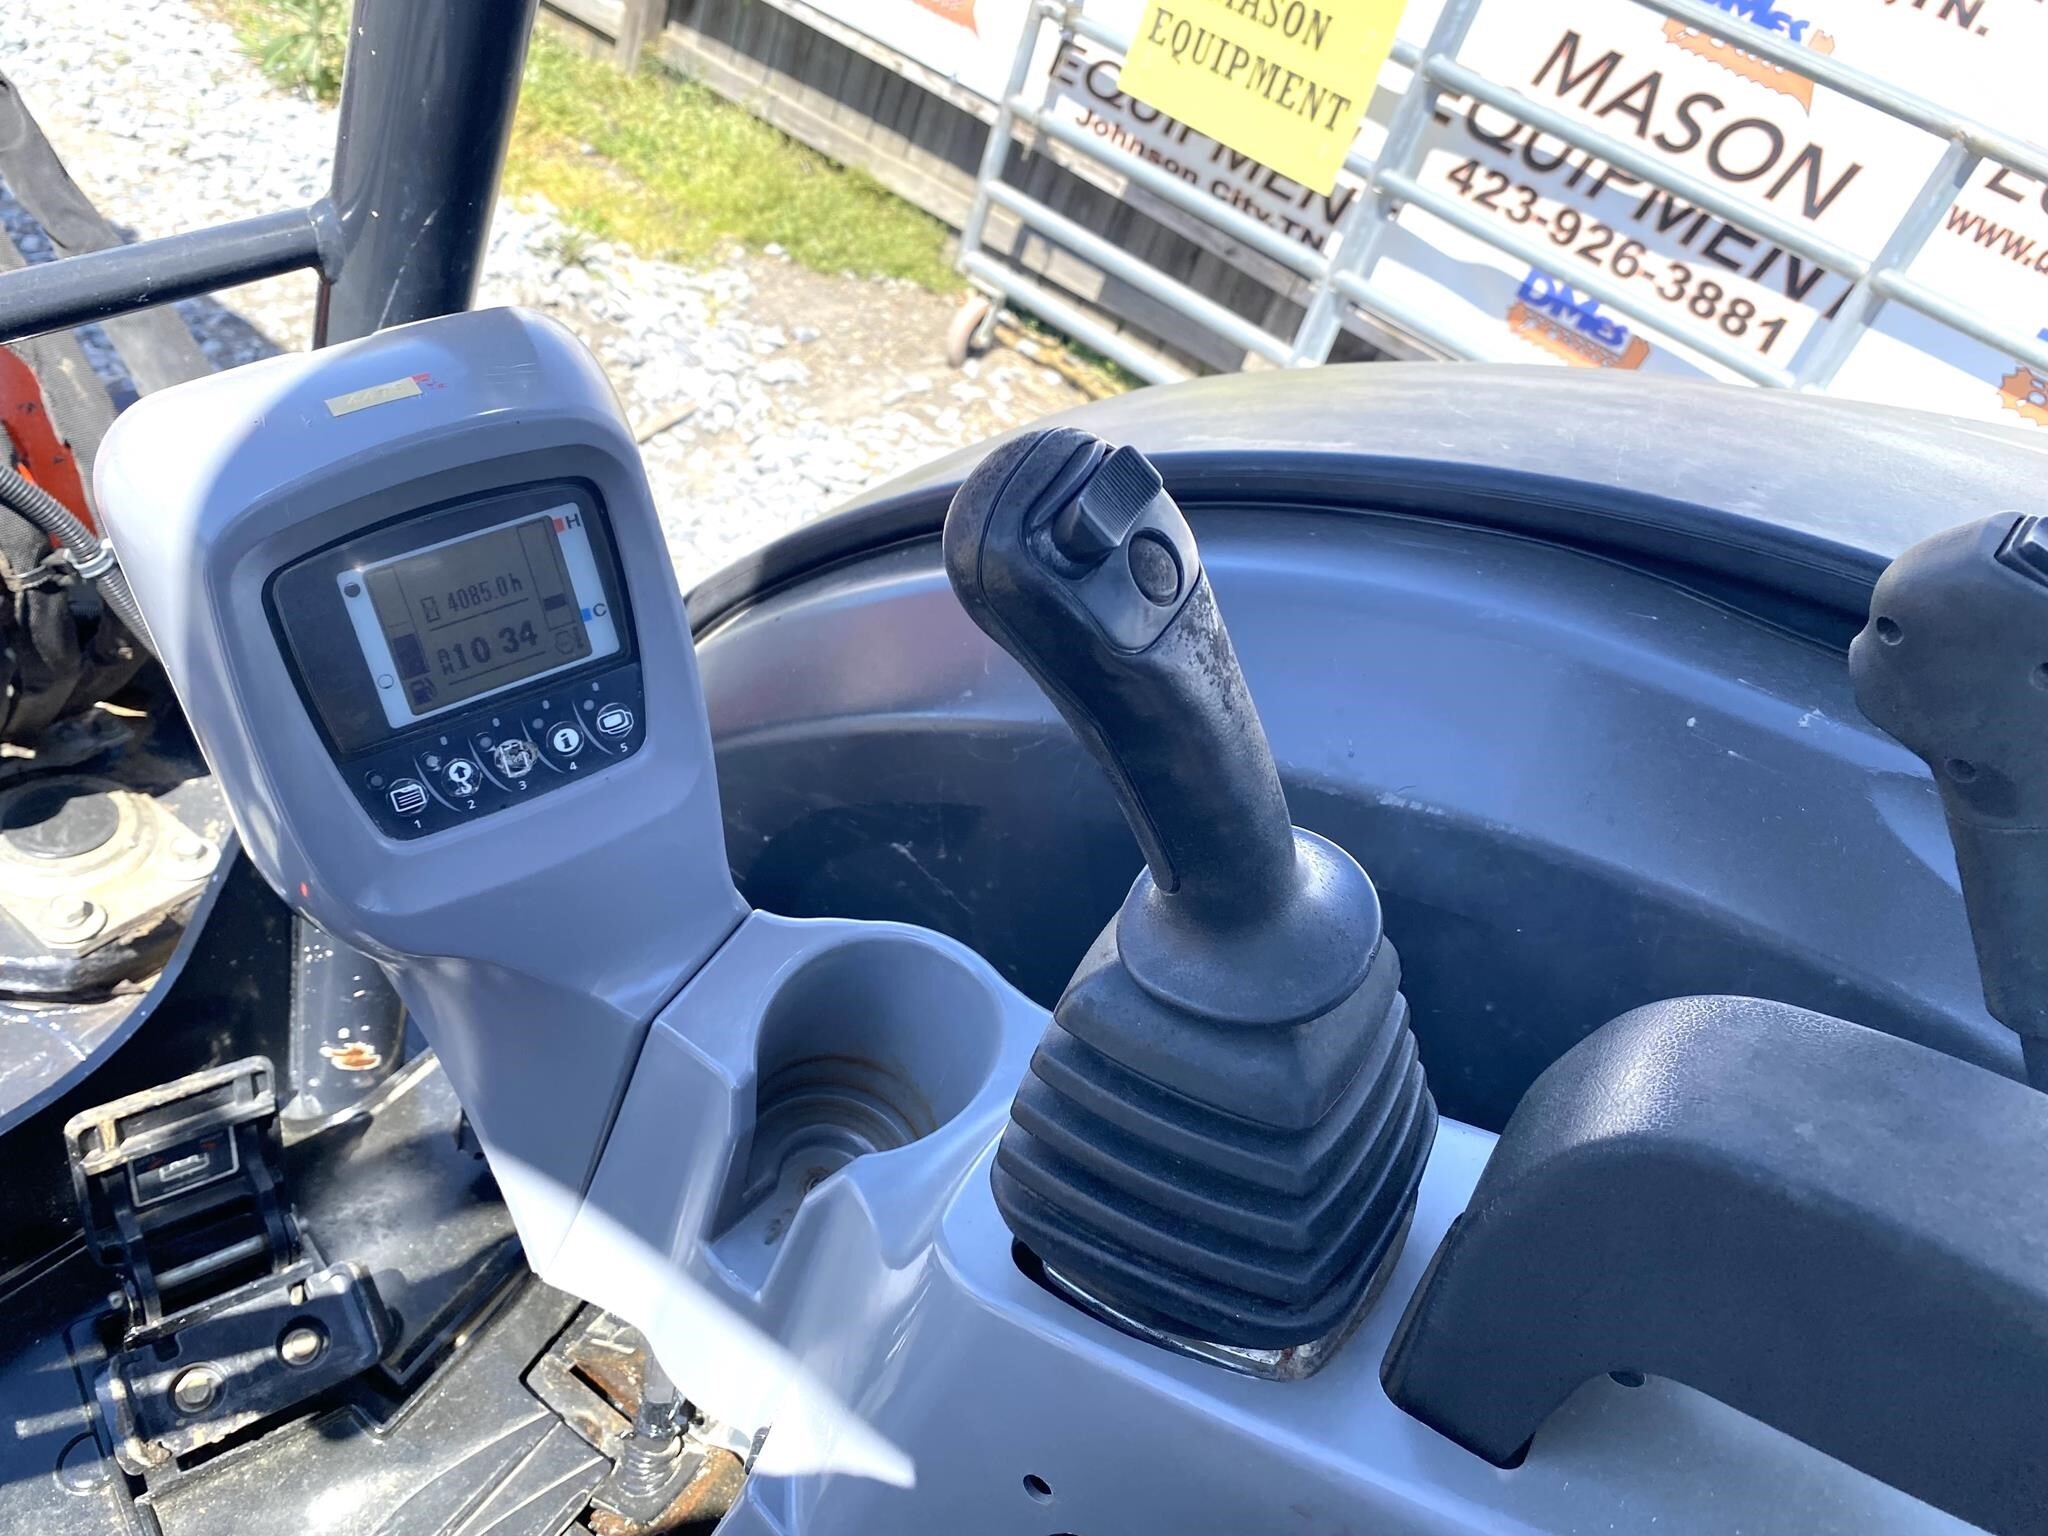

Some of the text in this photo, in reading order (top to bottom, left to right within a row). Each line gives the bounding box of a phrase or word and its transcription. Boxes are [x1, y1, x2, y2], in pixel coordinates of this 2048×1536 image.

[1224, 0, 1333, 51] ASON
[1147, 7, 1352, 132] EQUIPMENT
[1532, 29, 1863, 222] MASON
[1075, 108, 1199, 185] Johnson
[1446, 158, 1788, 355] 423-926-3881
[565, 513, 581, 529] H
[593, 603, 607, 617] C
[620, 742, 628, 753] 5
[569, 761, 578, 772] 4
[519, 780, 528, 791] 3
[467, 799, 476, 810] 2
[414, 819, 422, 829] 1
